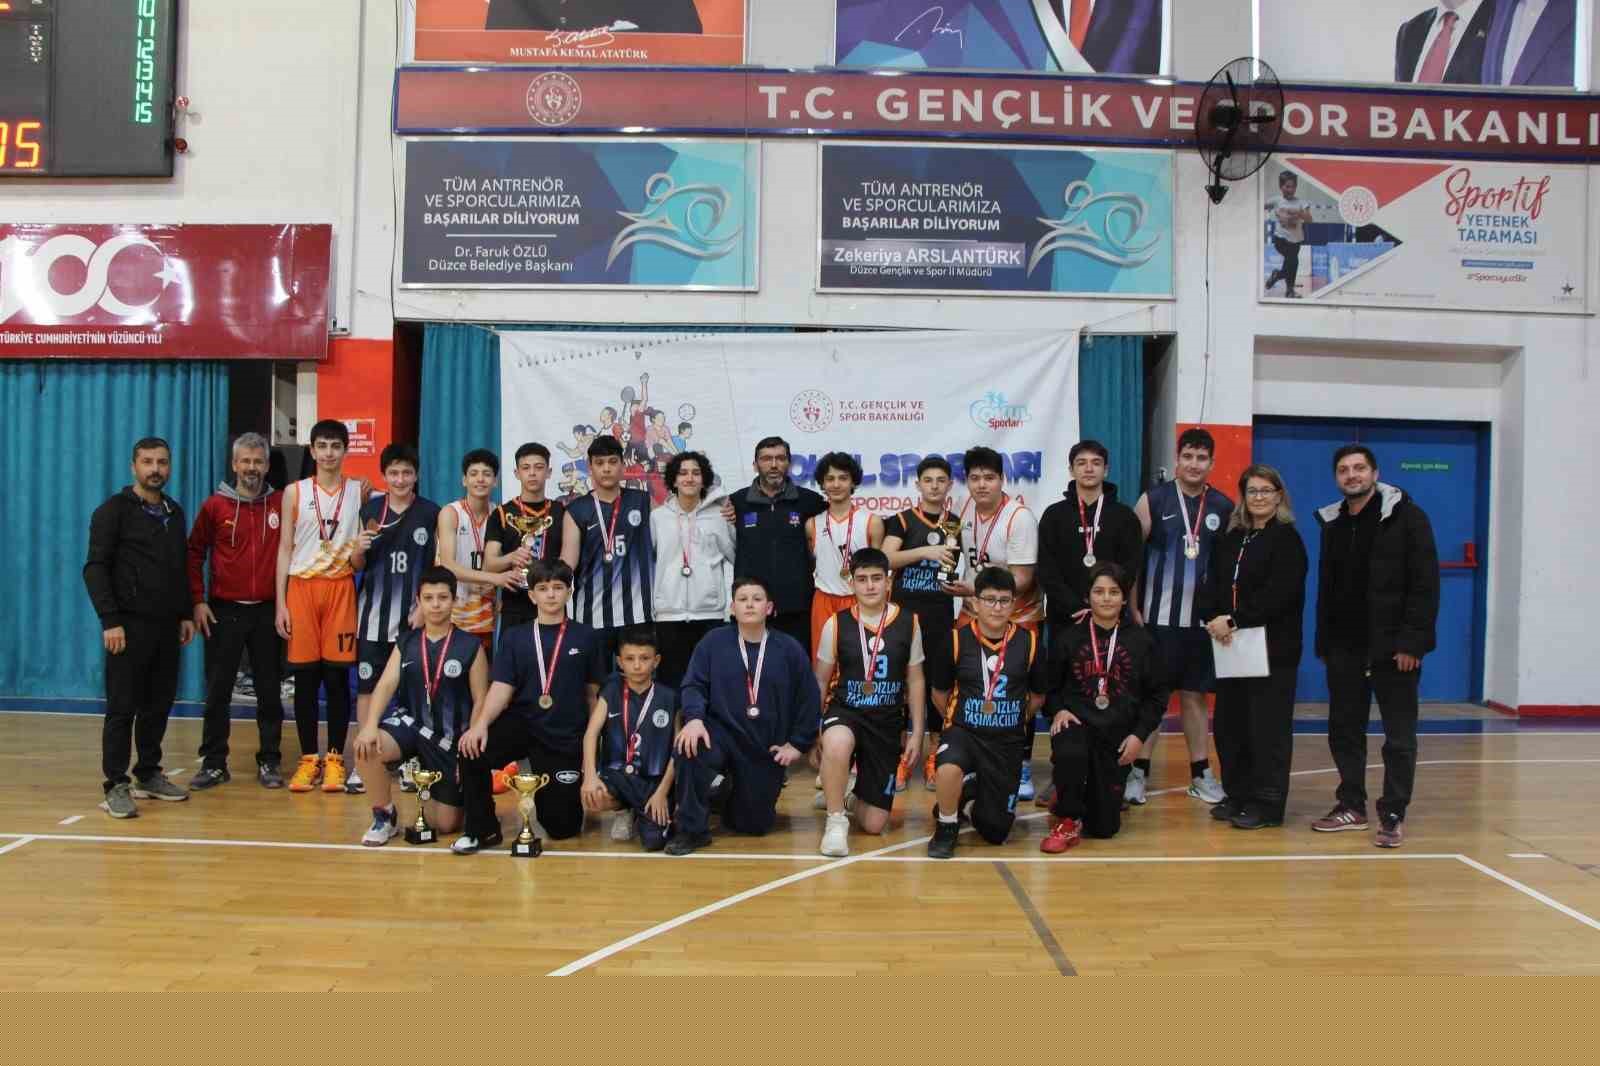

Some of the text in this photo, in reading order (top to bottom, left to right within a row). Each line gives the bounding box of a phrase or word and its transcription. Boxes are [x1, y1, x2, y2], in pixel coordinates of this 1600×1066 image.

[137, 39, 154, 59] 12
[510, 47, 648, 59] MUSTAFA KEMAL ATATÜRK
[136, 60, 153, 80] 13
[136, 82, 152, 100] 14
[135, 103, 152, 123] 15
[759, 86, 852, 120] T.C.
[876, 85, 1112, 127] GENÇLİK
[1131, 96, 1195, 129] VE
[1369, 106, 1599, 146] BAKANLI
[443, 176, 564, 192] TÜM ANTRENÖR
[862, 180, 983, 198] TÜM ANTRENÖR
[424, 194, 581, 208] VE SPORCULARIMIZA
[1445, 168, 1551, 225] Sportif
[842, 198, 1001, 214] VE SPORCULARIMIZA
[424, 211, 580, 227] BAŞARILAR DİLİYORUM
[842, 215, 1000, 231] BAŞARILAR DİLİYORUM
[1466, 214, 1529, 228] YETENEK
[1457, 228, 1537, 245] TARAMASI
[455, 244, 547, 257] Dr. Faruk ÖZLÜ
[834, 247, 1021, 265] Zekeriya ARSLANTÜRK
[428, 259, 573, 273] Düzce Belediye Başkanı
[851, 265, 877, 274] Düzce
[880, 265, 911, 276] Gençlik
[926, 267, 946, 277] Spor
[0, 330, 162, 345] TÜRKİYE CUMHURİYETİ'NİN YÜZÜNCÜ YILI
[840, 400, 924, 411] T.C. GENÇLİK VE
[840, 411, 924, 421] SPOR BAKANLIĞI
[390, 551, 408, 574] 18
[338, 633, 354, 653] 17
